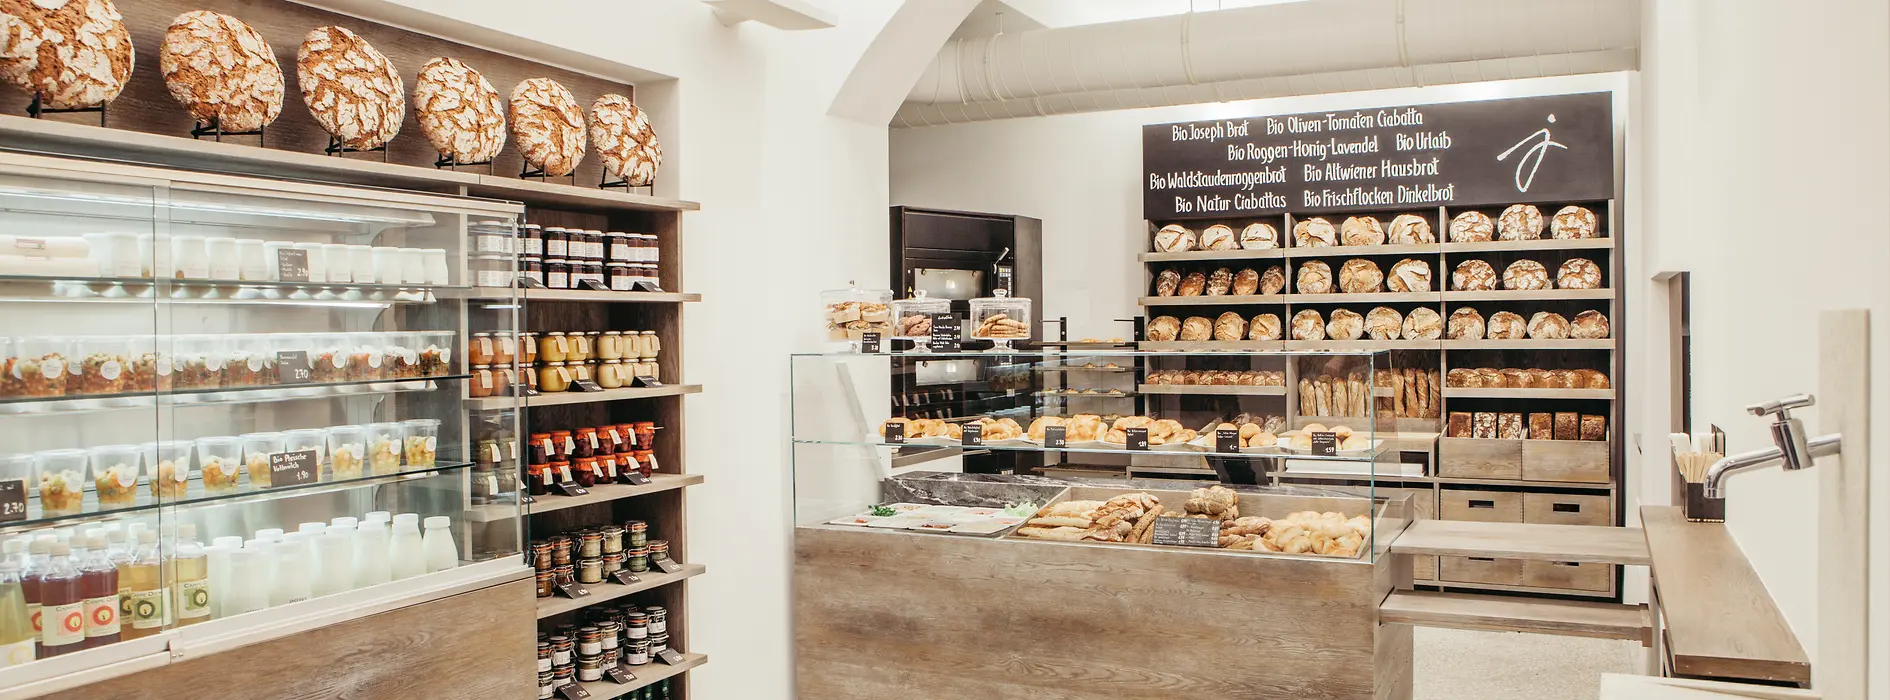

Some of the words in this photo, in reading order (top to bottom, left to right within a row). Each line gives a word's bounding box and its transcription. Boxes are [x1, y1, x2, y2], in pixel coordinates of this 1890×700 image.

[1172, 125, 1188, 141] Bio
[1189, 122, 1223, 142] Joseph
[1227, 120, 1249, 138] Brot
[1267, 117, 1284, 135] Bio
[1287, 111, 1374, 134] Oliven-Tomaten
[1377, 107, 1423, 127] Ciabatta
[1228, 144, 1245, 161] Bio
[1247, 135, 1379, 165] Roggen-Honig-Lavendel
[1396, 133, 1414, 151] Bio
[1415, 131, 1452, 150] Urlaib
[1150, 172, 1166, 190] Bio
[1167, 165, 1287, 191] Waldstaudenroggenbrot
[1304, 163, 1322, 182] Bio
[1325, 162, 1378, 181] Altwiener
[1381, 157, 1440, 178] Hausbrot
[1175, 196, 1192, 213] Bio
[1196, 194, 1231, 212] Natur
[1234, 192, 1287, 210] Ciabattas
[1304, 190, 1321, 207] Bio
[1322, 186, 1393, 207] Frischflocken
[1397, 183, 1454, 204] Dinkelbrot
[273, 455, 283, 464] Bio
[4, 502, 25, 515] 2.70
